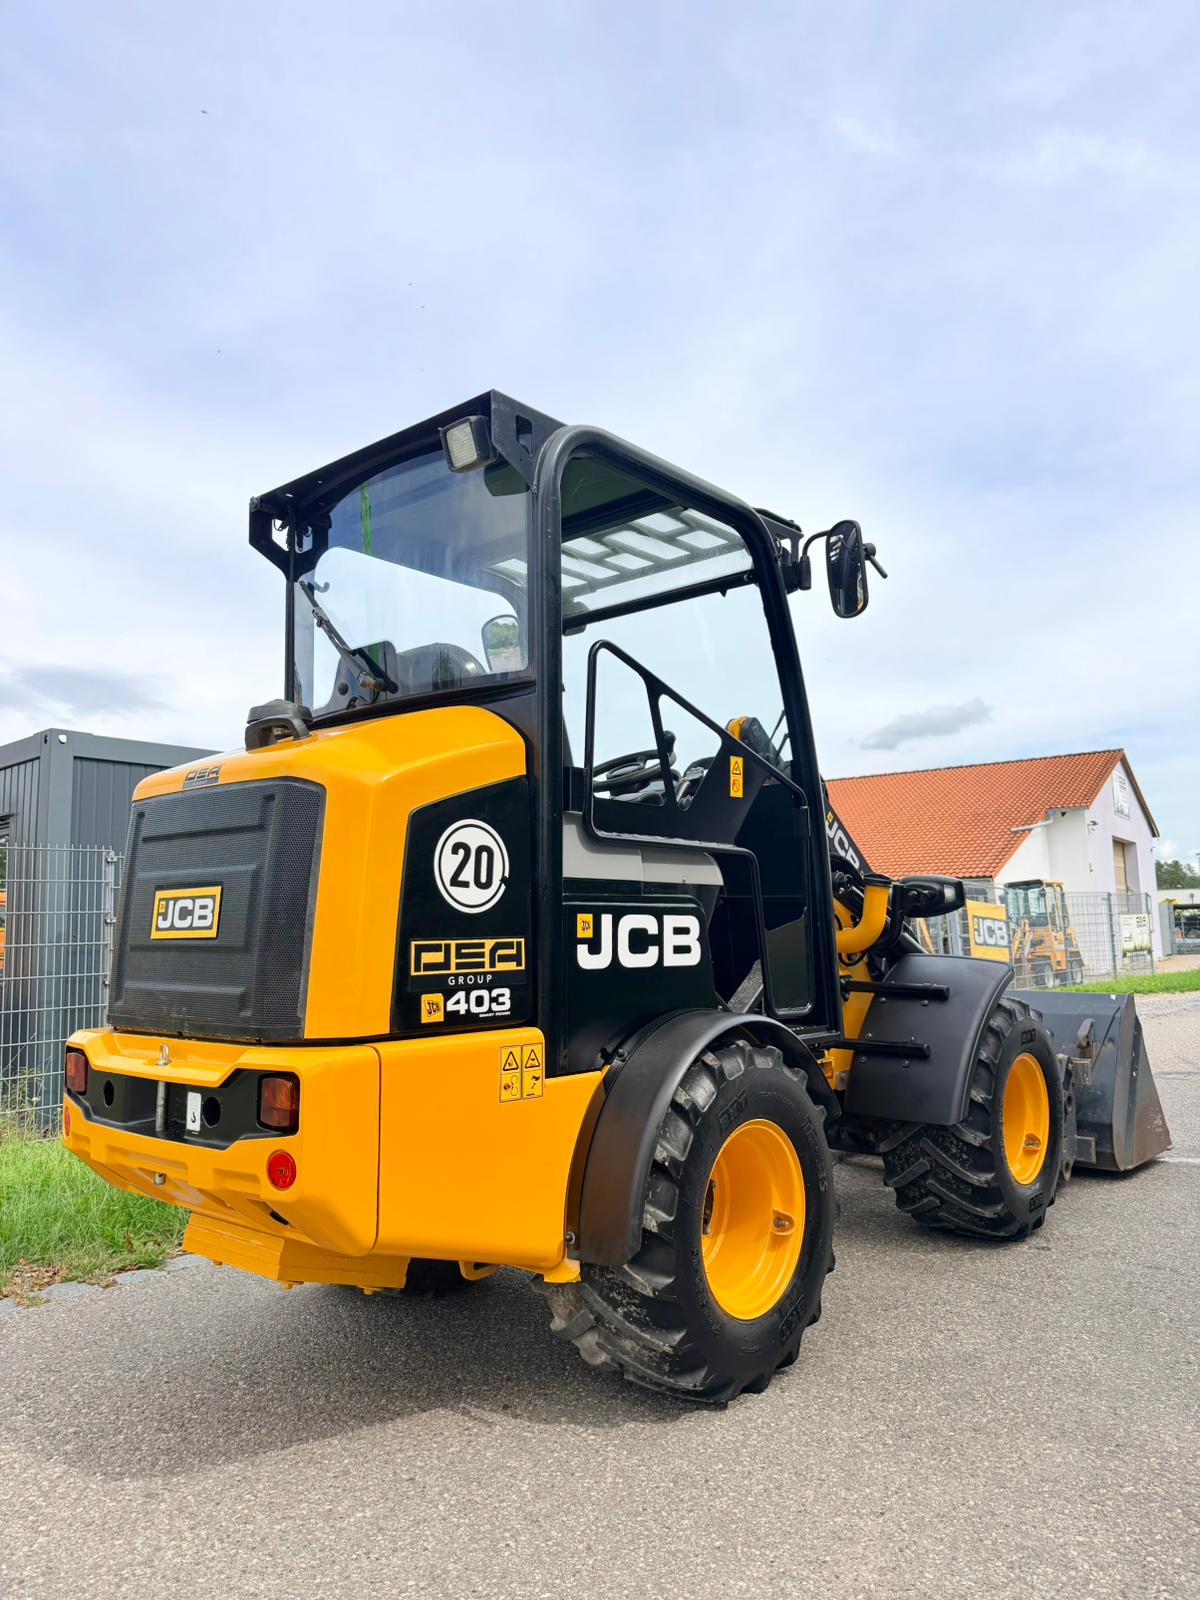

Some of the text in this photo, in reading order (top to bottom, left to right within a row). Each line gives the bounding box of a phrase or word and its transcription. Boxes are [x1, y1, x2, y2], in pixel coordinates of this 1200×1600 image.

[449, 841, 495, 890] 20
[157, 897, 214, 929] JCB
[577, 914, 702, 970] JCB
[973, 917, 1009, 946] JCB
[447, 974, 493, 986] GROUP
[446, 987, 511, 1015] 403
